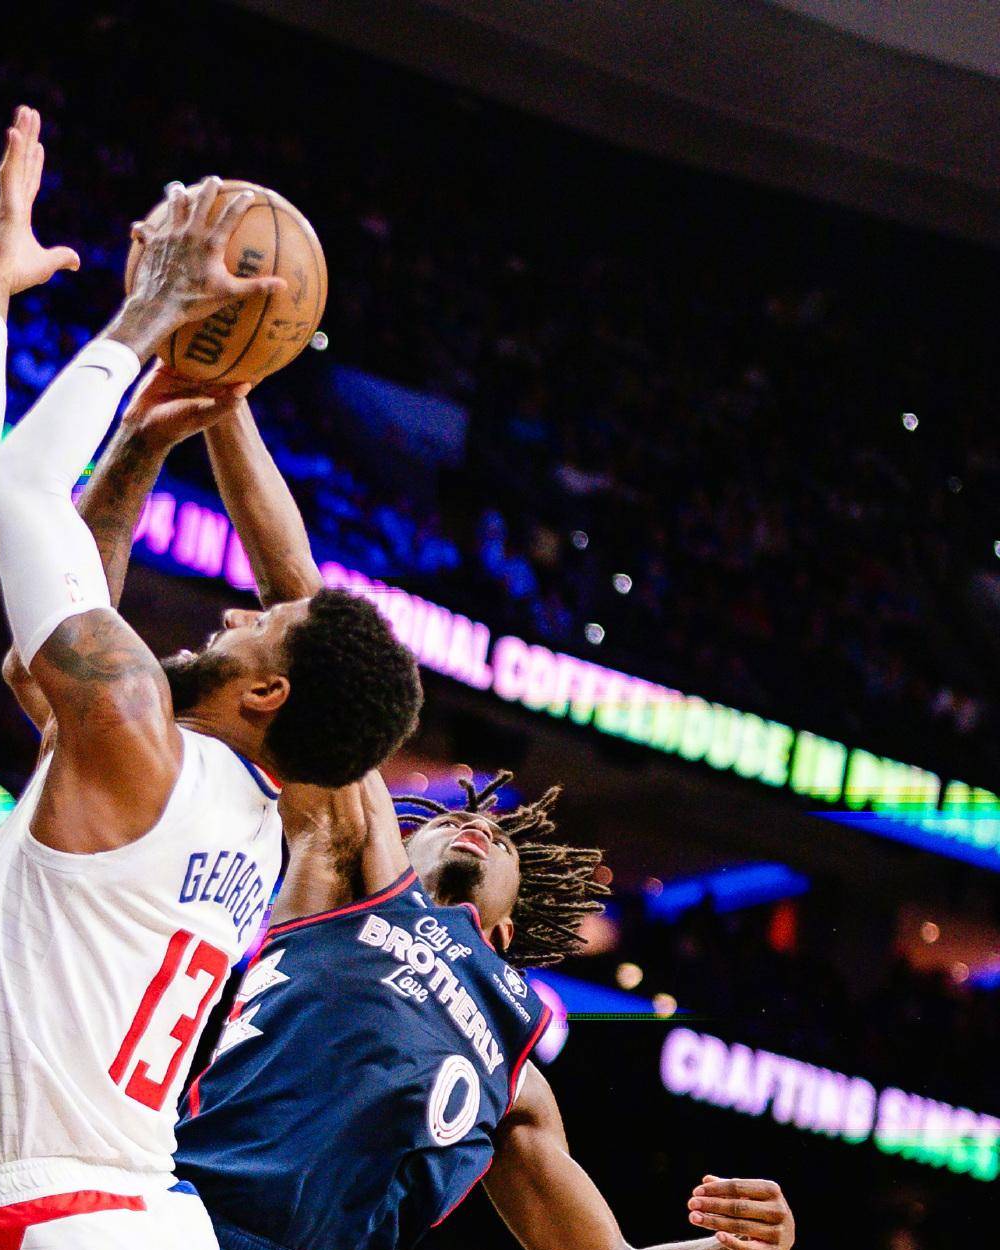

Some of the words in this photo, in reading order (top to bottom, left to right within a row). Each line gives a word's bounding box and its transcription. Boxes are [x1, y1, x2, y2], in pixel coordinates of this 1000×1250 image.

[492, 634, 796, 788] COFFEEHOUSE
[789, 729, 849, 804] IN
[179, 850, 264, 944] GEORGE
[414, 915, 452, 951] City
[107, 927, 230, 1112] 13
[358, 913, 505, 1075] BROTHERLY
[381, 964, 430, 1004] Love
[428, 1053, 481, 1147] 0
[659, 1026, 877, 1144] CRAFTING
